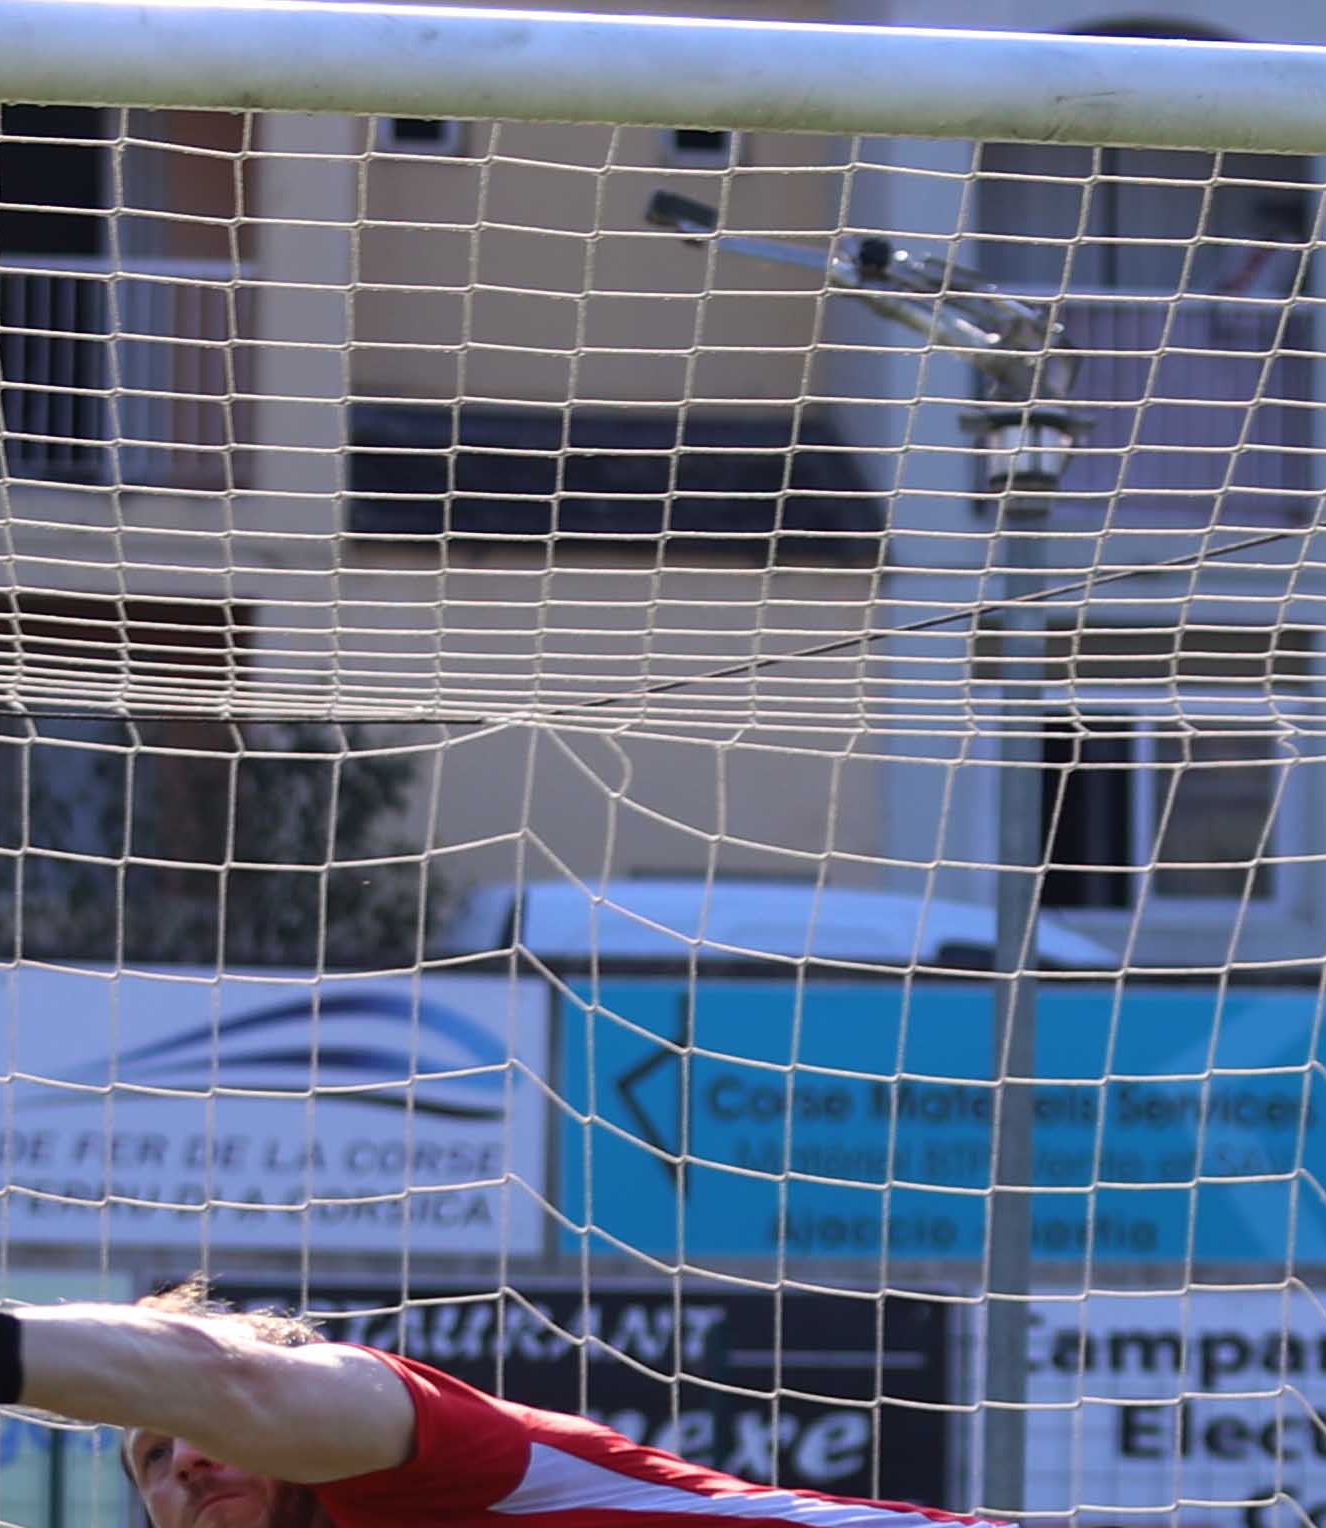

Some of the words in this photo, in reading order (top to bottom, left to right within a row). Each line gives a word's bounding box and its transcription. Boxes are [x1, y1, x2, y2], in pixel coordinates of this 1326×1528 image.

[706, 1074, 854, 1122] Corse
[1115, 1085, 1317, 1131] Services
[77, 1130, 169, 1168] FER
[185, 1133, 251, 1171] DE
[263, 1135, 327, 1173] LA
[345, 1139, 503, 1175] CORSE
[289, 1187, 494, 1228] CORSICA
